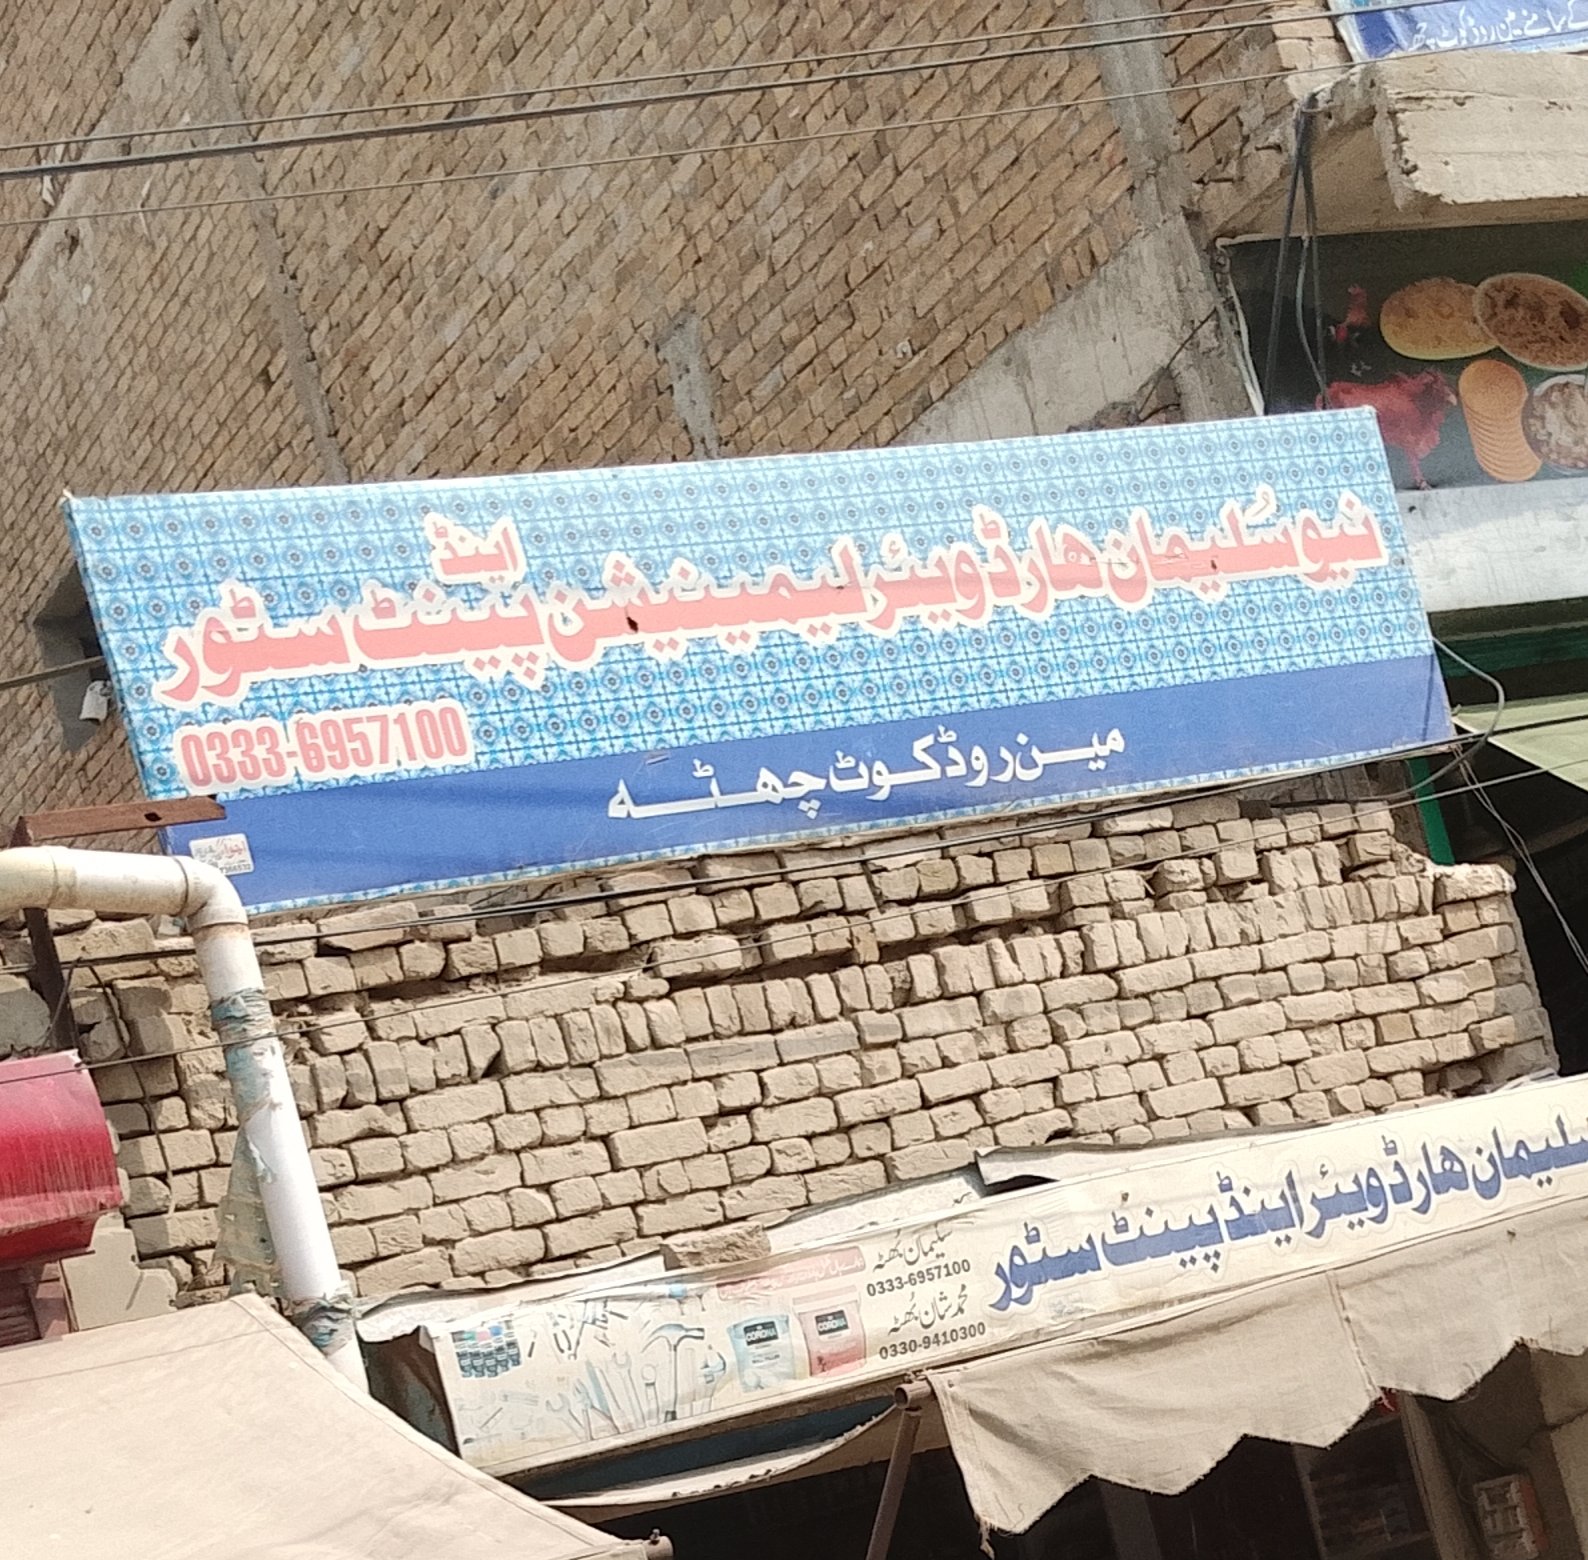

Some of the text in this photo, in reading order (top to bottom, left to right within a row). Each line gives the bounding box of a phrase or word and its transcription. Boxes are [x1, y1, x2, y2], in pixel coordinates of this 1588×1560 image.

[434, 519, 520, 582] اینڈ
[162, 588, 350, 701] سٹور
[360, 583, 545, 686] پینٹ
[180, 706, 467, 787] 0333-6957100
[829, 735, 938, 802] کوٹ
[936, 726, 1012, 784] روڈ
[1013, 726, 1124, 780] مین
[1101, 1207, 1224, 1272] پینٹ
[1219, 1170, 1298, 1246] اینڈ
[866, 1259, 971, 1297] 0333-6957100
[989, 1222, 1101, 1311] سٹور
[879, 1322, 986, 1360] 0330-9410300
